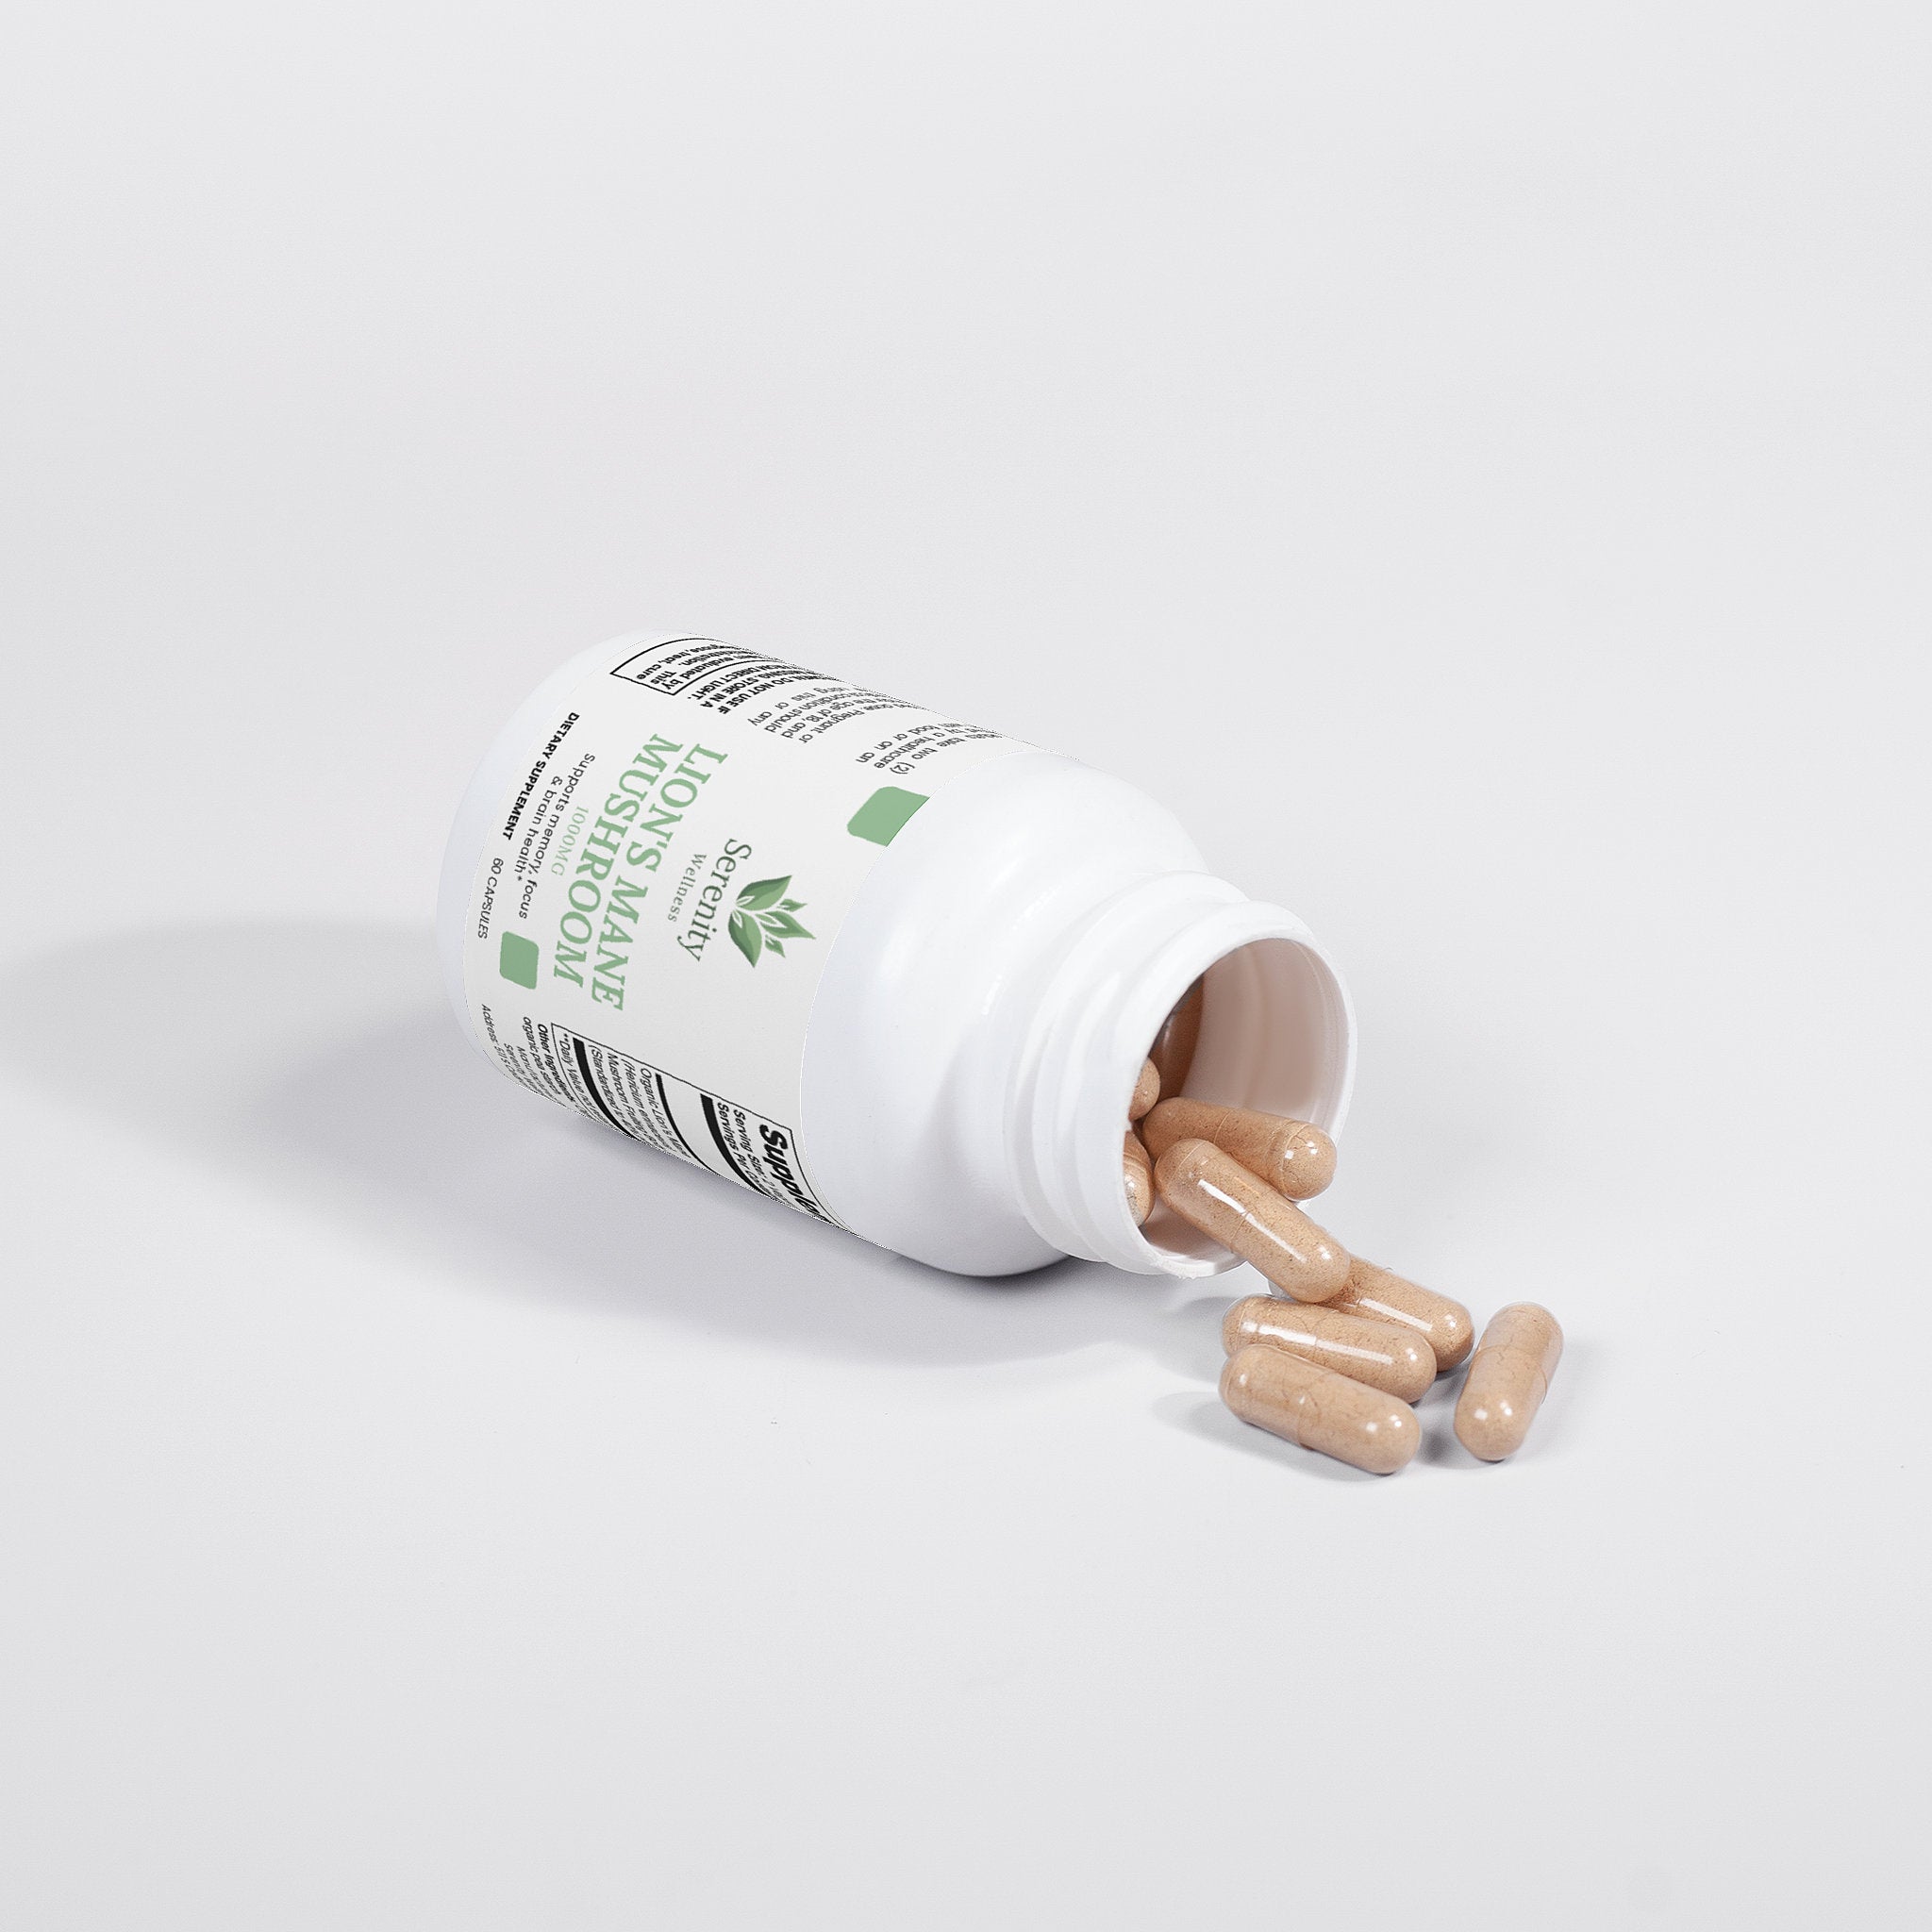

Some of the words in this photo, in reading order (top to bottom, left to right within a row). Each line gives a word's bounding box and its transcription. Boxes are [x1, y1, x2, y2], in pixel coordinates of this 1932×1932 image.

[636, 663, 661, 679] cure
[650, 671, 676, 684] This
[679, 657, 734, 679] evaluated
[720, 666, 759, 683] DIRECT
[662, 680, 683, 690] by
[709, 692, 726, 702] IN
[721, 676, 758, 694] STORE
[747, 682, 774, 695] NOT
[718, 706, 731, 714] IF
[725, 692, 751, 708] USE
[747, 711, 772, 725] any
[764, 708, 802, 733] should
[802, 714, 824, 723] 18,
[810, 709, 865, 733] Pregnant
[818, 708, 831, 717] of
[542, 712, 580, 759] DIETARY
[781, 722, 806, 739] and
[799, 733, 813, 743] or
[856, 752, 874, 763] an
[874, 741, 892, 750] on
[874, 736, 936, 769] healthcare
[911, 747, 939, 759] two
[890, 761, 915, 774] (2)
[551, 775, 563, 786] &
[556, 753, 595, 811] Supports
[503, 760, 546, 840] SUPPLEMENT
[533, 789, 557, 824] brain
[625, 743, 728, 873] LION'S
[528, 814, 559, 874] memory,
[551, 807, 589, 875] 1000MG
[491, 858, 504, 874] 60
[554, 734, 684, 988] MUSHROOM
[519, 879, 538, 919] focus
[668, 854, 707, 922] Wellness
[677, 839, 752, 961] Serenity
[477, 876, 497, 939] CAPSULES
[591, 875, 648, 1011] MANE
[523, 1016, 539, 1053] organic
[538, 1024, 550, 1053] Other
[567, 1067, 584, 1094] Value
[607, 1052, 628, 1104] Mushroom
[640, 1068, 658, 1108] Organic
[717, 1102, 739, 1151] Servings
[734, 1151, 750, 1170] Per
[733, 1109, 753, 1153] Serving
